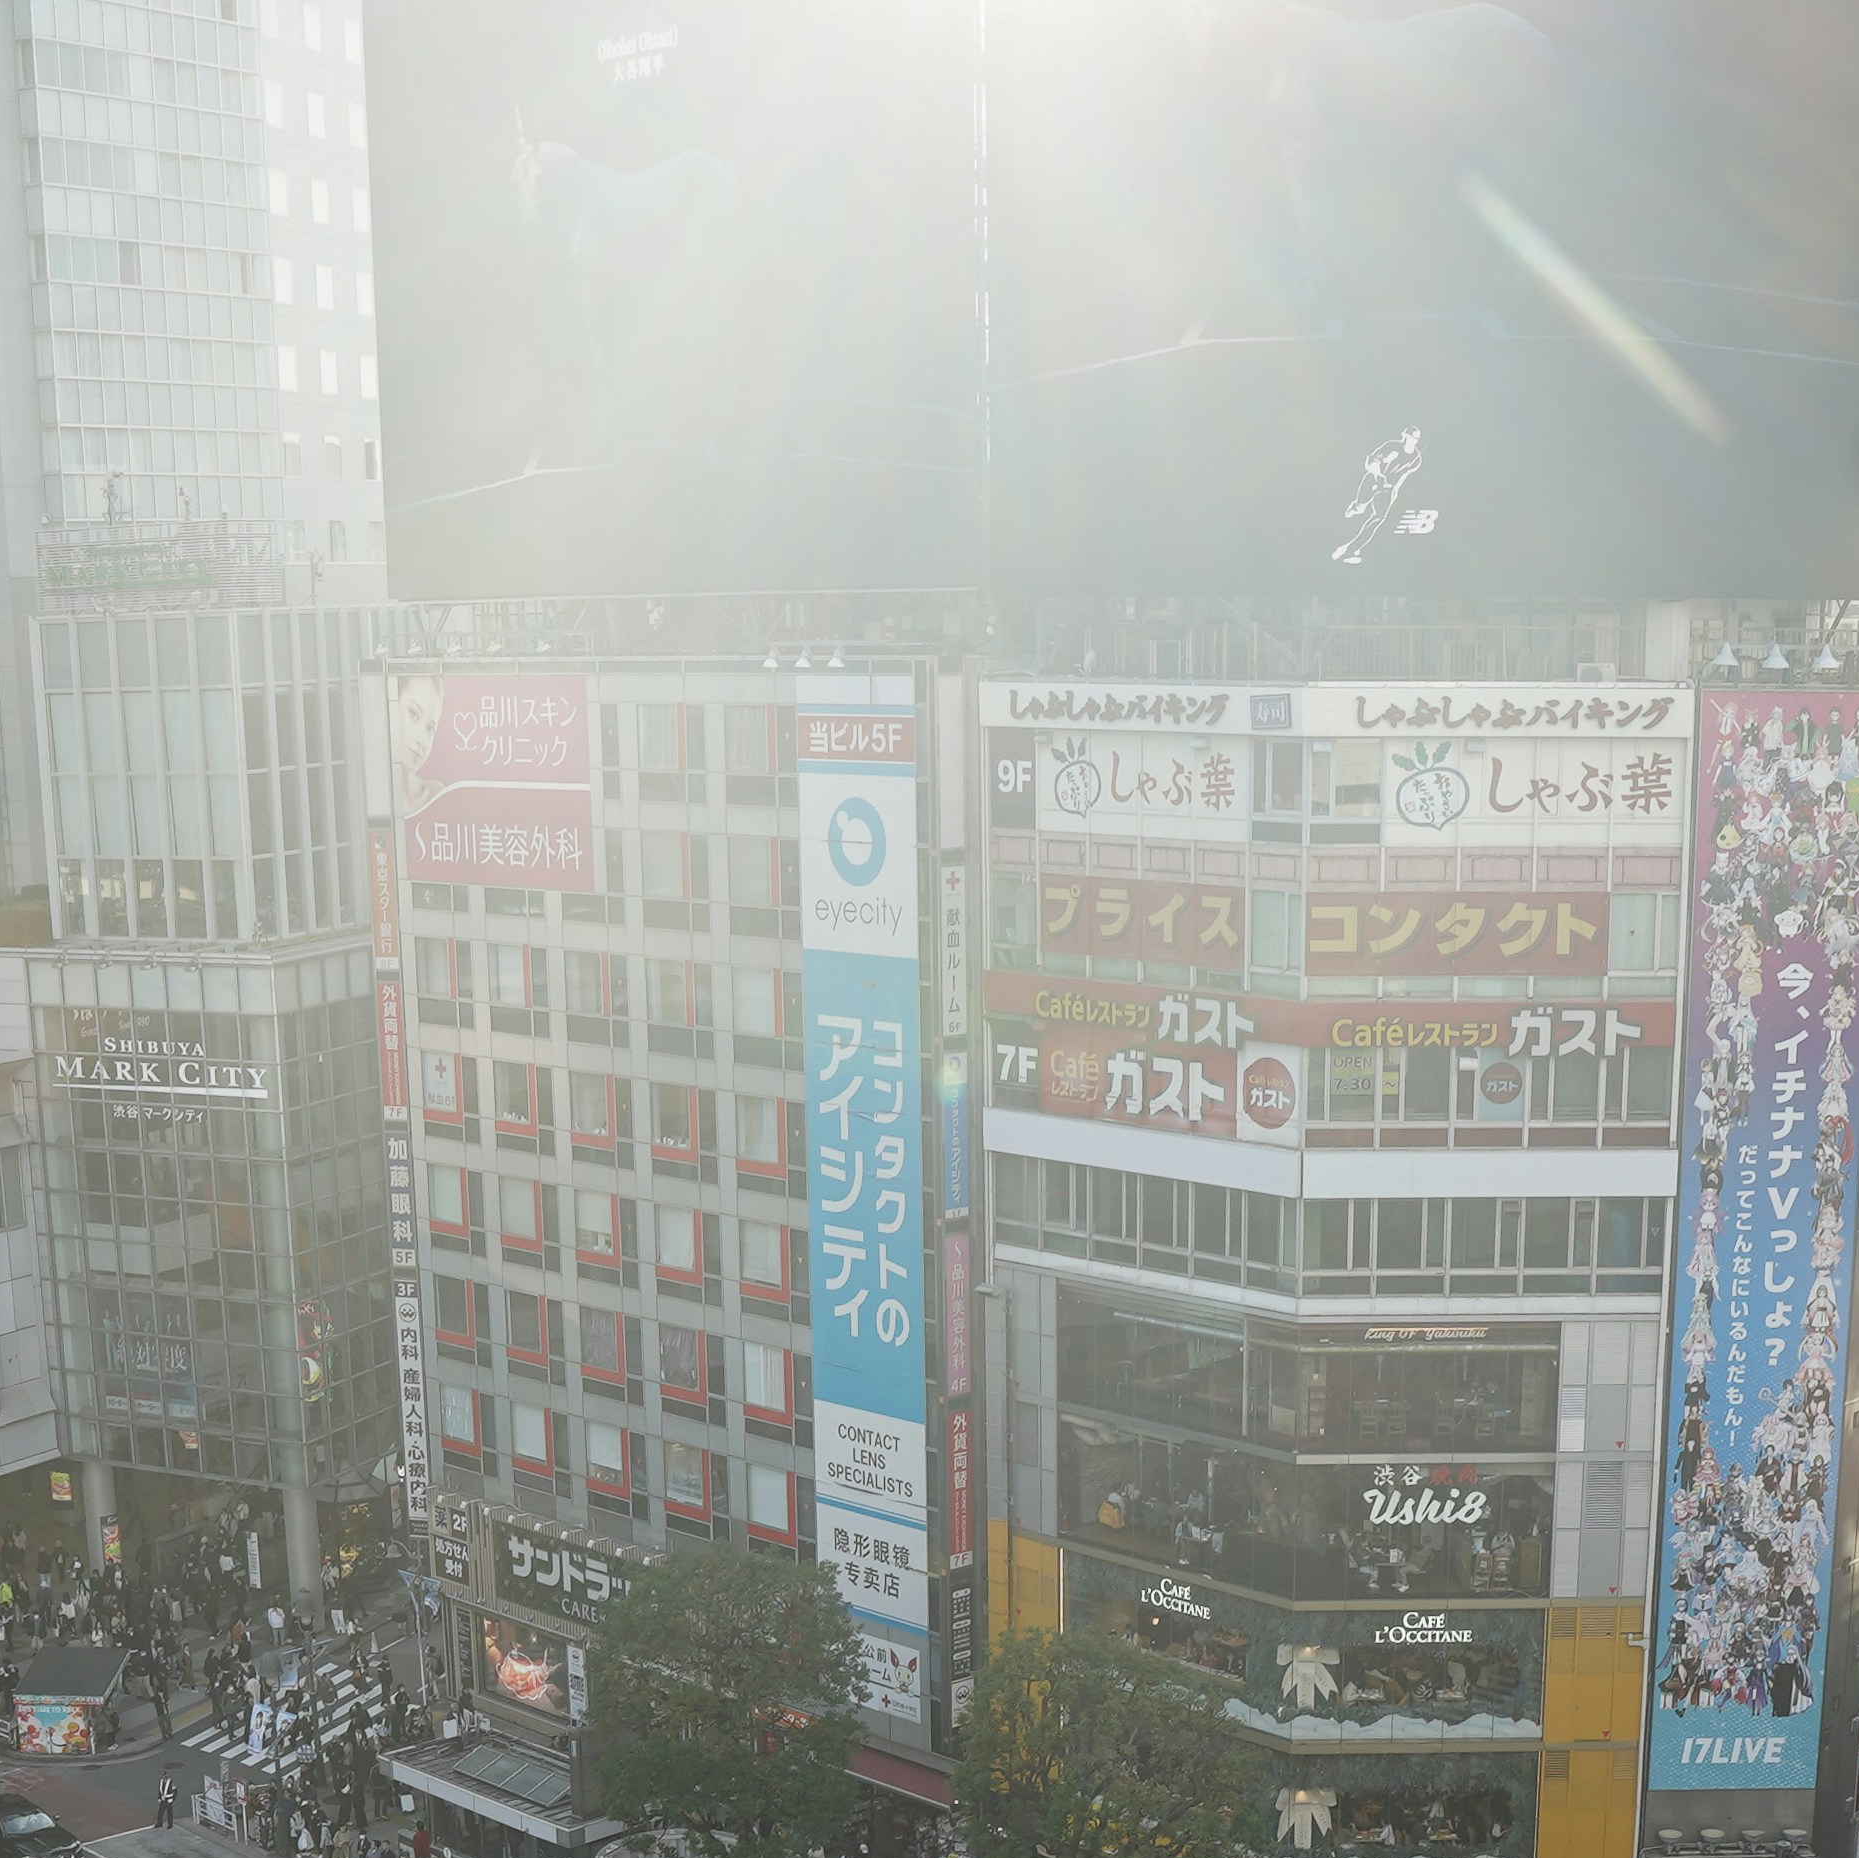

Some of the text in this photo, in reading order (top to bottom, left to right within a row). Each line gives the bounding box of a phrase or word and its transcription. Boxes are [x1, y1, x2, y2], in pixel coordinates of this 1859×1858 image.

[479, 695, 579, 729] 品川スキン
[1008, 689, 1231, 726] しゃぶしゃぶバイキング
[1356, 696, 1674, 731] しゃぶしゃぶバイキング
[480, 735, 569, 767] クリニック
[809, 720, 903, 754] 当ビル5F
[997, 758, 1033, 794] 9F
[1110, 751, 1235, 811] しゃぶ葉
[1489, 752, 1673, 815] しゃぶ葉
[430, 822, 583, 871] 品川美容外科
[374, 852, 393, 954] 東京スター銀行
[814, 896, 903, 937] eyecity
[1044, 883, 1240, 948] プライス
[1309, 902, 1599, 958] コンタクト
[945, 907, 961, 1015] 献血ルーム
[382, 984, 399, 1051] 外貨両替
[948, 1021, 961, 1033] 6F
[1157, 993, 1255, 1049] ガスト
[1509, 1007, 1642, 1057] ガスト
[104, 1036, 205, 1057] SHIBUYA
[997, 1043, 1040, 1083] 7F
[1333, 1055, 1373, 1068] OPEN
[55, 1055, 268, 1088] MARK CITY
[1049, 1049, 1100, 1081] Café
[1050, 1080, 1099, 1103] レストラン
[1105, 1050, 1225, 1121] ガスト
[1249, 1087, 1291, 1109] ガスト
[1333, 1077, 1371, 1091] 7:30
[1486, 1080, 1519, 1092] ガスト
[388, 1107, 404, 1118] 7F
[388, 1137, 414, 1243] 加藤眼科
[816, 1012, 869, 1339] アイシティ
[871, 1020, 911, 1348] コンタクトの
[396, 1251, 413, 1264] 5F
[397, 1282, 415, 1297] 3F
[951, 1263, 967, 1369] 品川美容外科
[401, 1327, 420, 1362] 内科
[950, 1376, 968, 1393] 4F
[838, 1423, 901, 1453] CONTACT
[952, 1413, 968, 1489] 外貨両替
[852, 1447, 886, 1470] LENS
[828, 1462, 914, 1498] SPECIALISTS
[434, 1506, 448, 1530] 薬
[1363, 1487, 1488, 1525] Ushi8
[435, 1538, 469, 1561] 処方せん
[834, 1527, 911, 1568] 隐形眼镜
[953, 1555, 969, 1568] 7F
[444, 1559, 464, 1578] 受付
[844, 1561, 901, 1598] 专卖店
[1140, 1587, 1212, 1620] L'OCCITANE
[1375, 1625, 1474, 1646] L'OCCITANE
[1680, 1736, 1788, 1765] 17LIVE
